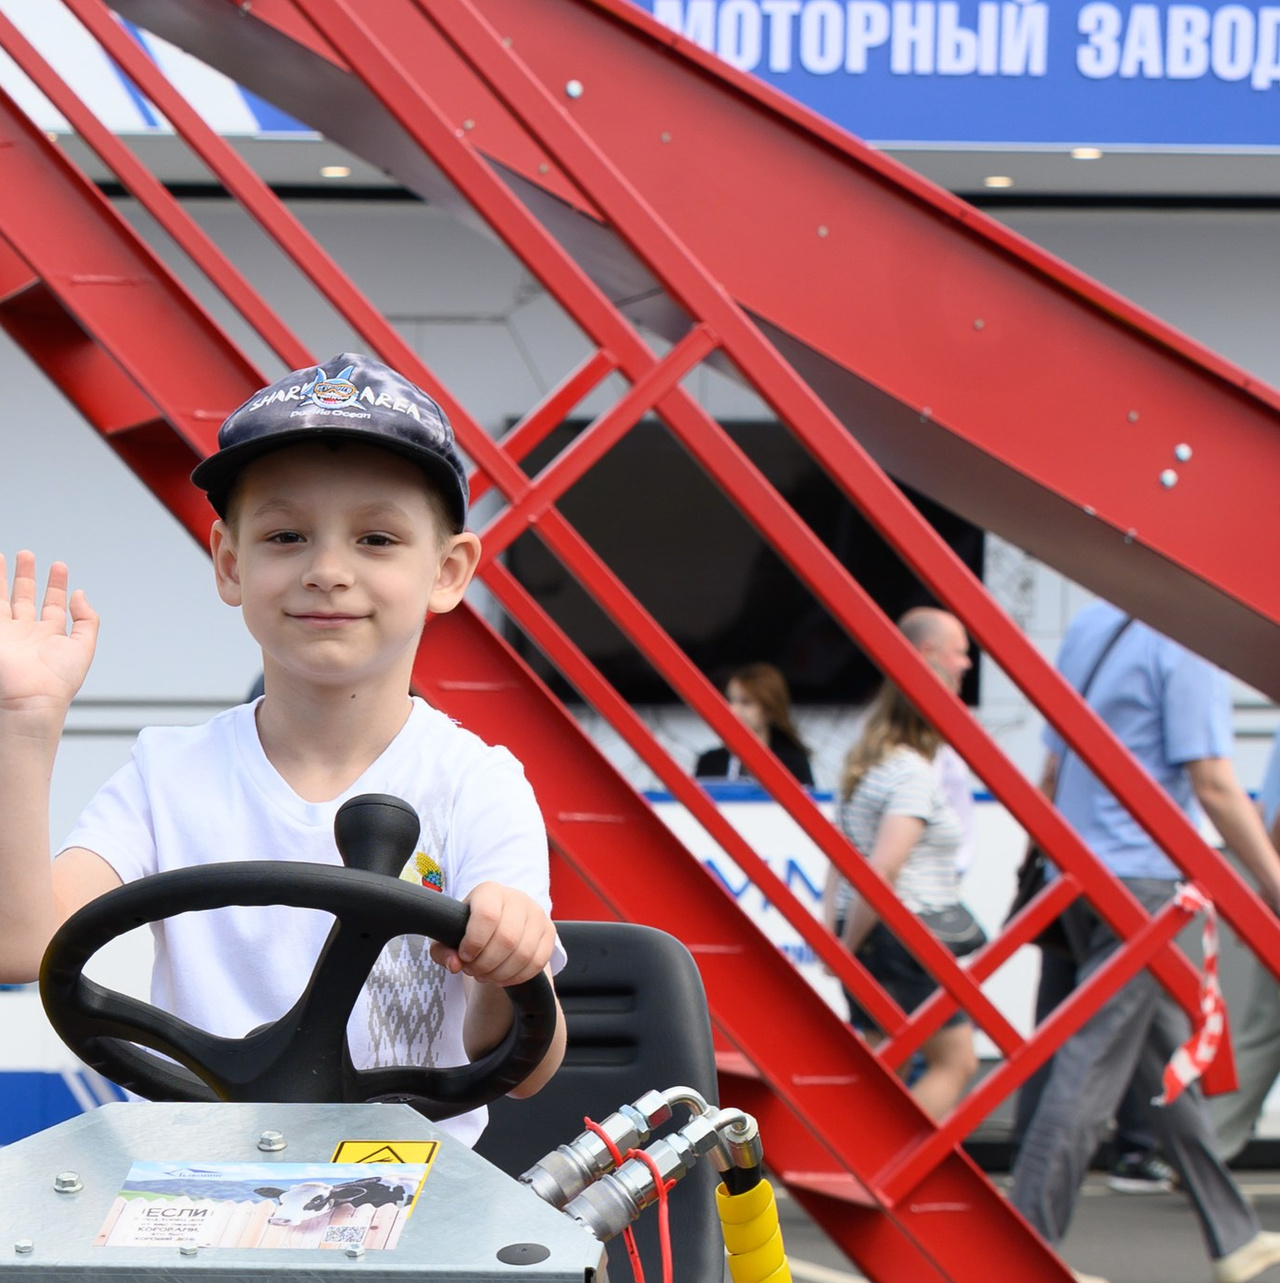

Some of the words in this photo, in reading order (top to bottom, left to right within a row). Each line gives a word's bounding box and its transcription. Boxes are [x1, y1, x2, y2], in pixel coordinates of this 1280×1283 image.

[1076, 1, 1280, 90] ЗАВОД
[332, 409, 371, 419] Ocean
[360, 386, 421, 422] AREA
[146, 1208, 208, 1217] ЕСЛИ
